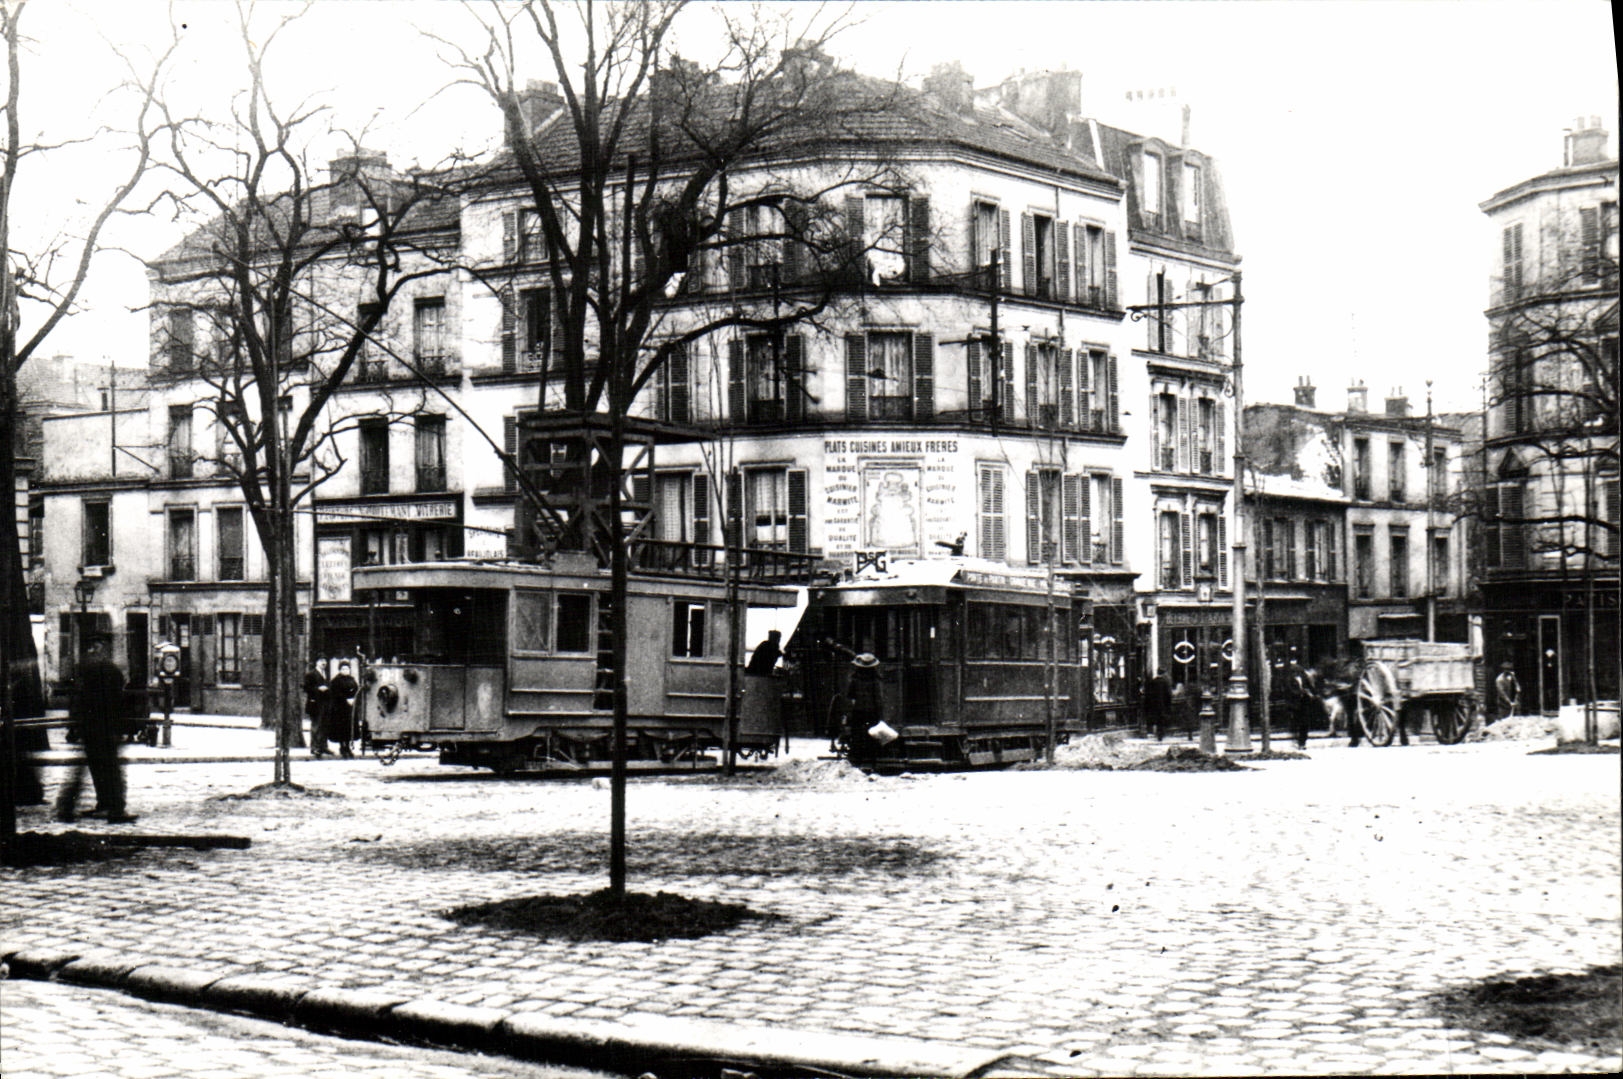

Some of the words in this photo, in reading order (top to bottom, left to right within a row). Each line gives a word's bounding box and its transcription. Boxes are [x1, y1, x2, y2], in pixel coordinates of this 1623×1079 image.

[824, 440, 847, 454] PLATS
[850, 440, 888, 454] CUISINES
[891, 440, 923, 454] AMIEUX
[925, 440, 959, 454] FRERES
[826, 465, 856, 473] MARQUE
[415, 502, 453, 517] VITRERIE
